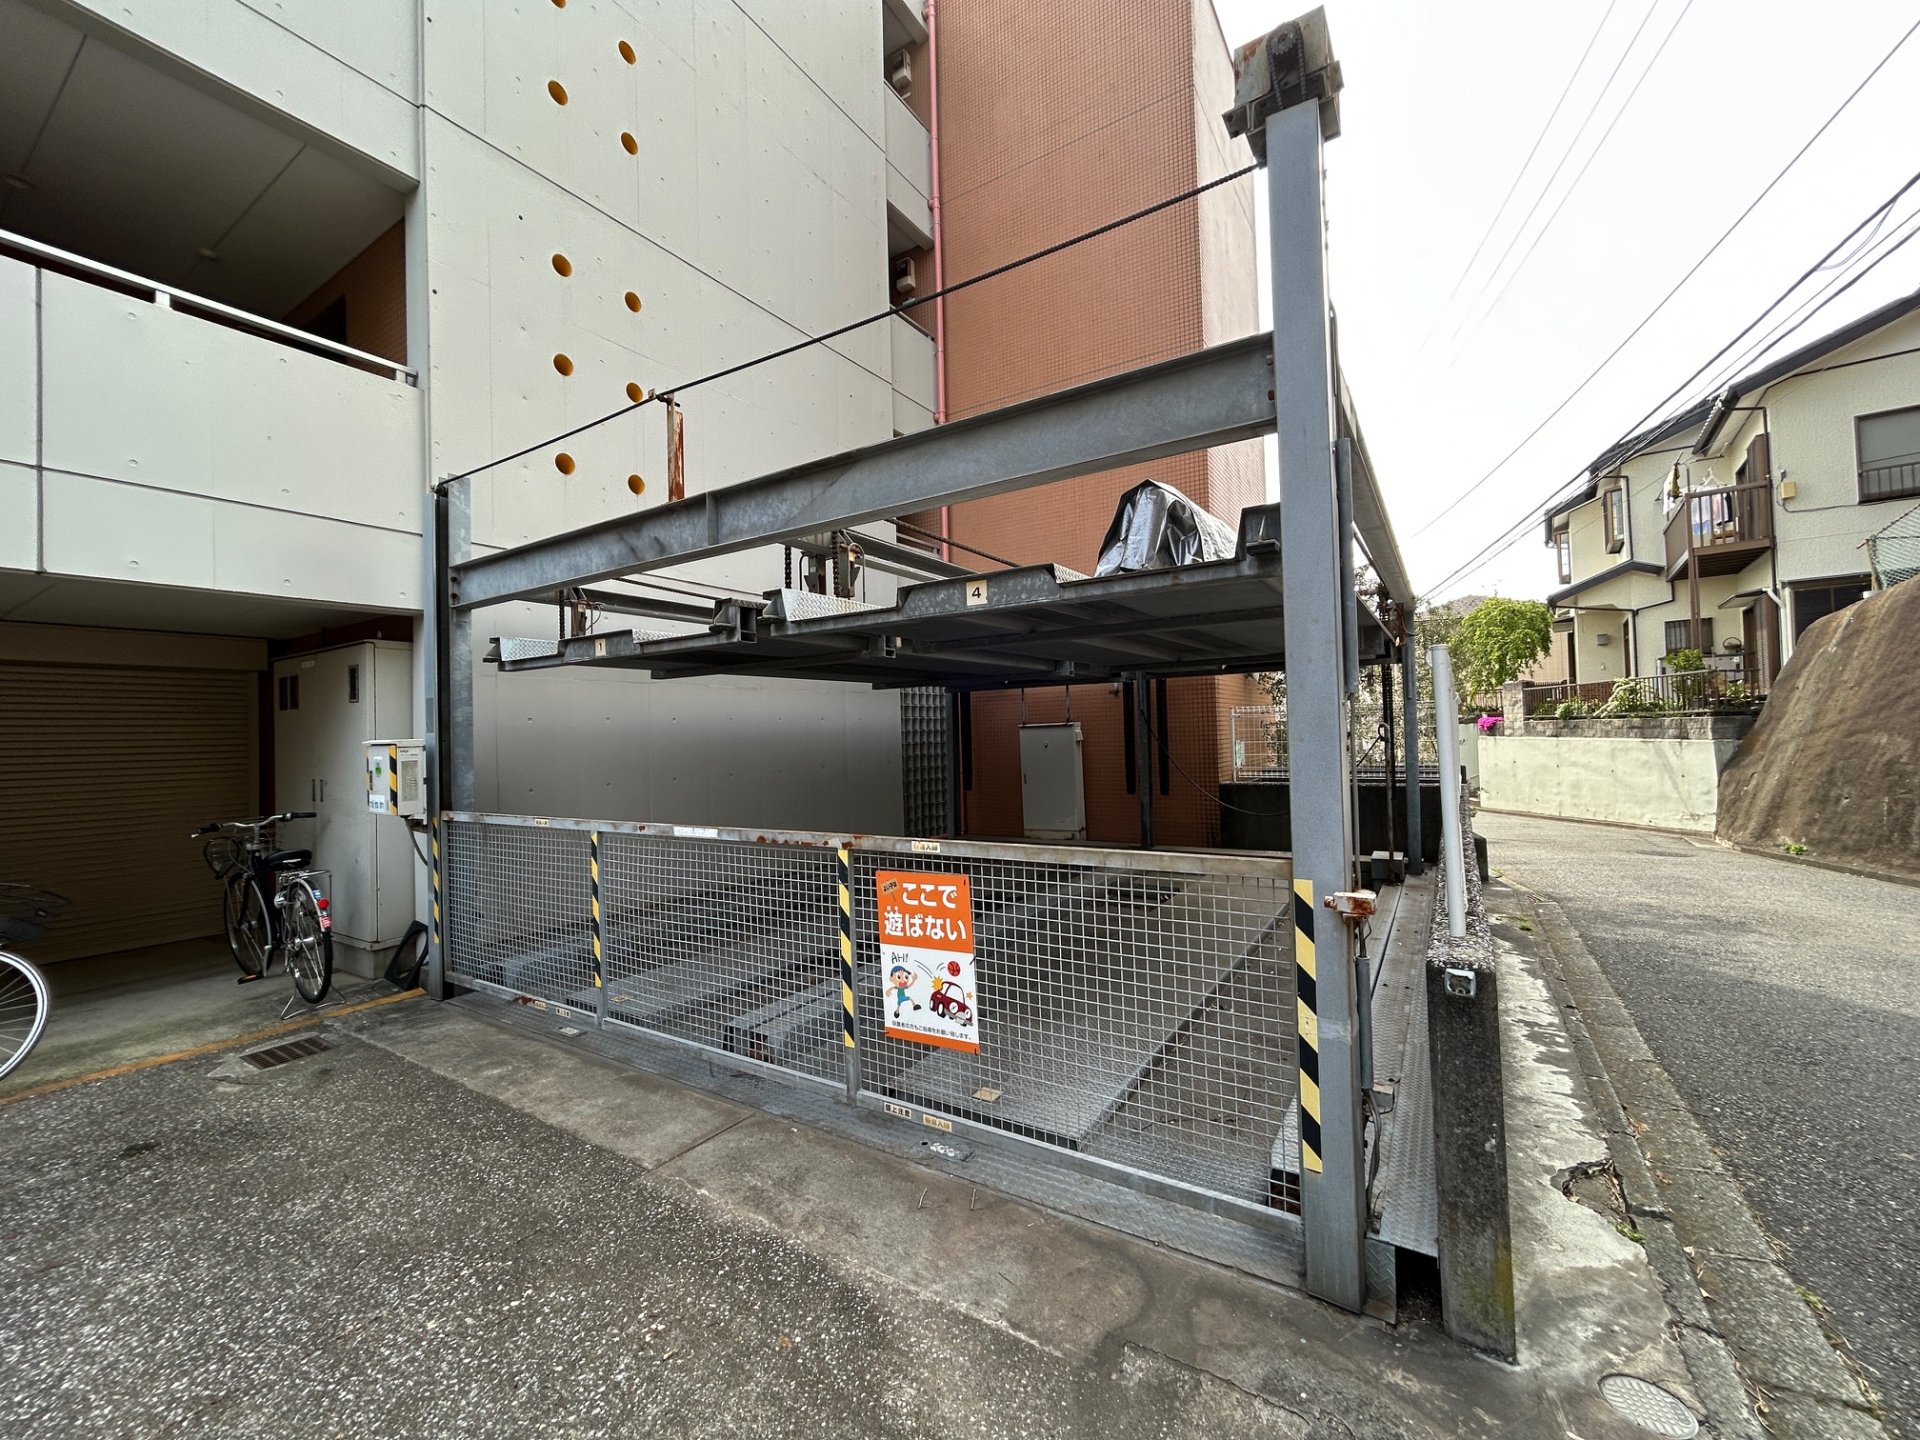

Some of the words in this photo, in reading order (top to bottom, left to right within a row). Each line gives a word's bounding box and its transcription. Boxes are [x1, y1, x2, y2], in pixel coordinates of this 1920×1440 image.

[972, 586, 981, 598] 4
[902, 883, 958, 909] ここで
[884, 911, 967, 941] 遊ばない
[891, 951, 909, 965] AH!
